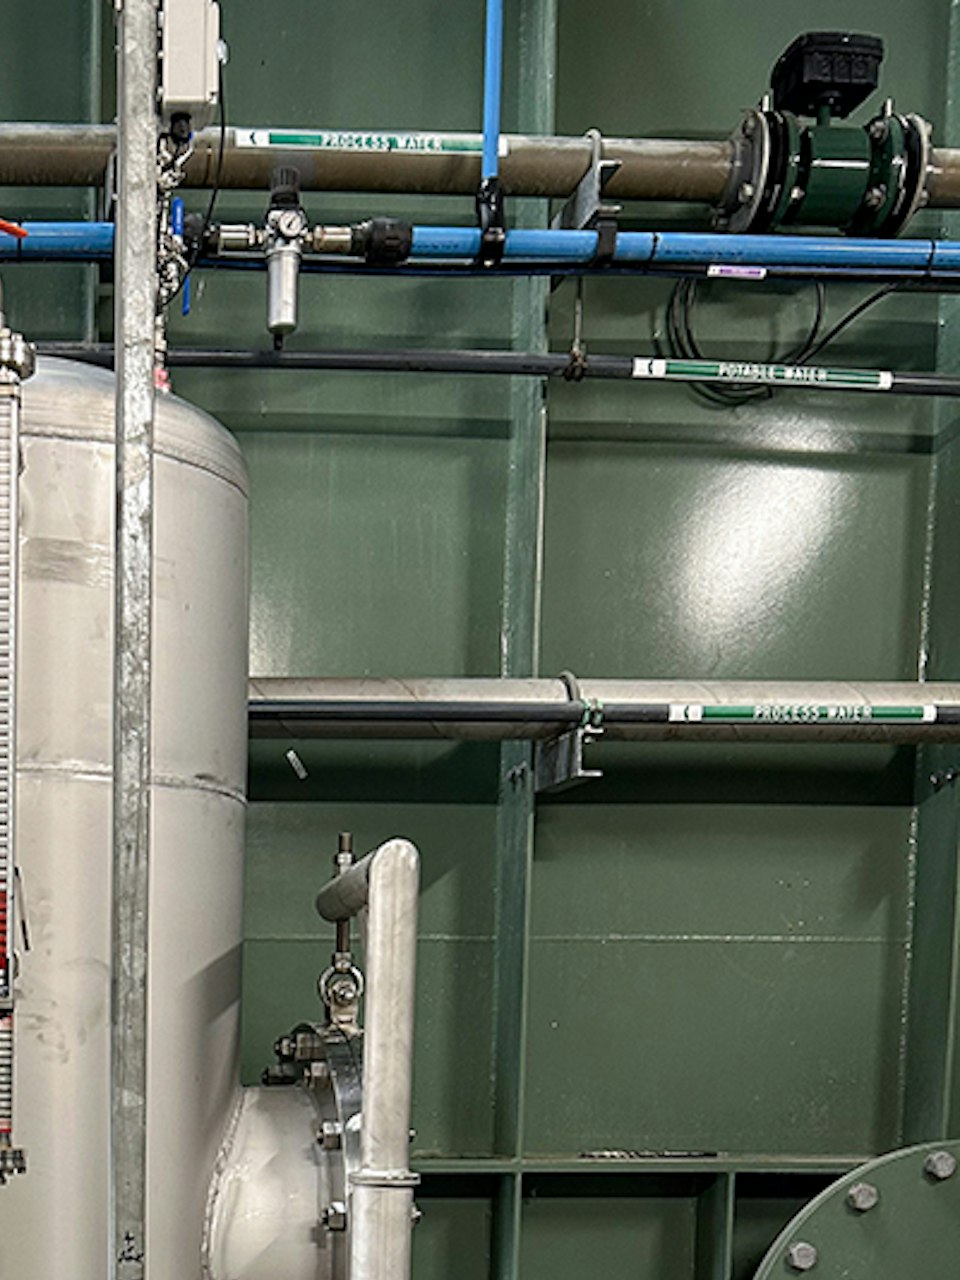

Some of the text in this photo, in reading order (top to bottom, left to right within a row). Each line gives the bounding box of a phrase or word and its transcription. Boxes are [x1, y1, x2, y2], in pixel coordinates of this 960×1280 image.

[321, 132, 443, 151] PROCESS WATER
[719, 362, 827, 381] POTABLE WATER
[754, 705, 872, 721] PROCESS WATER
